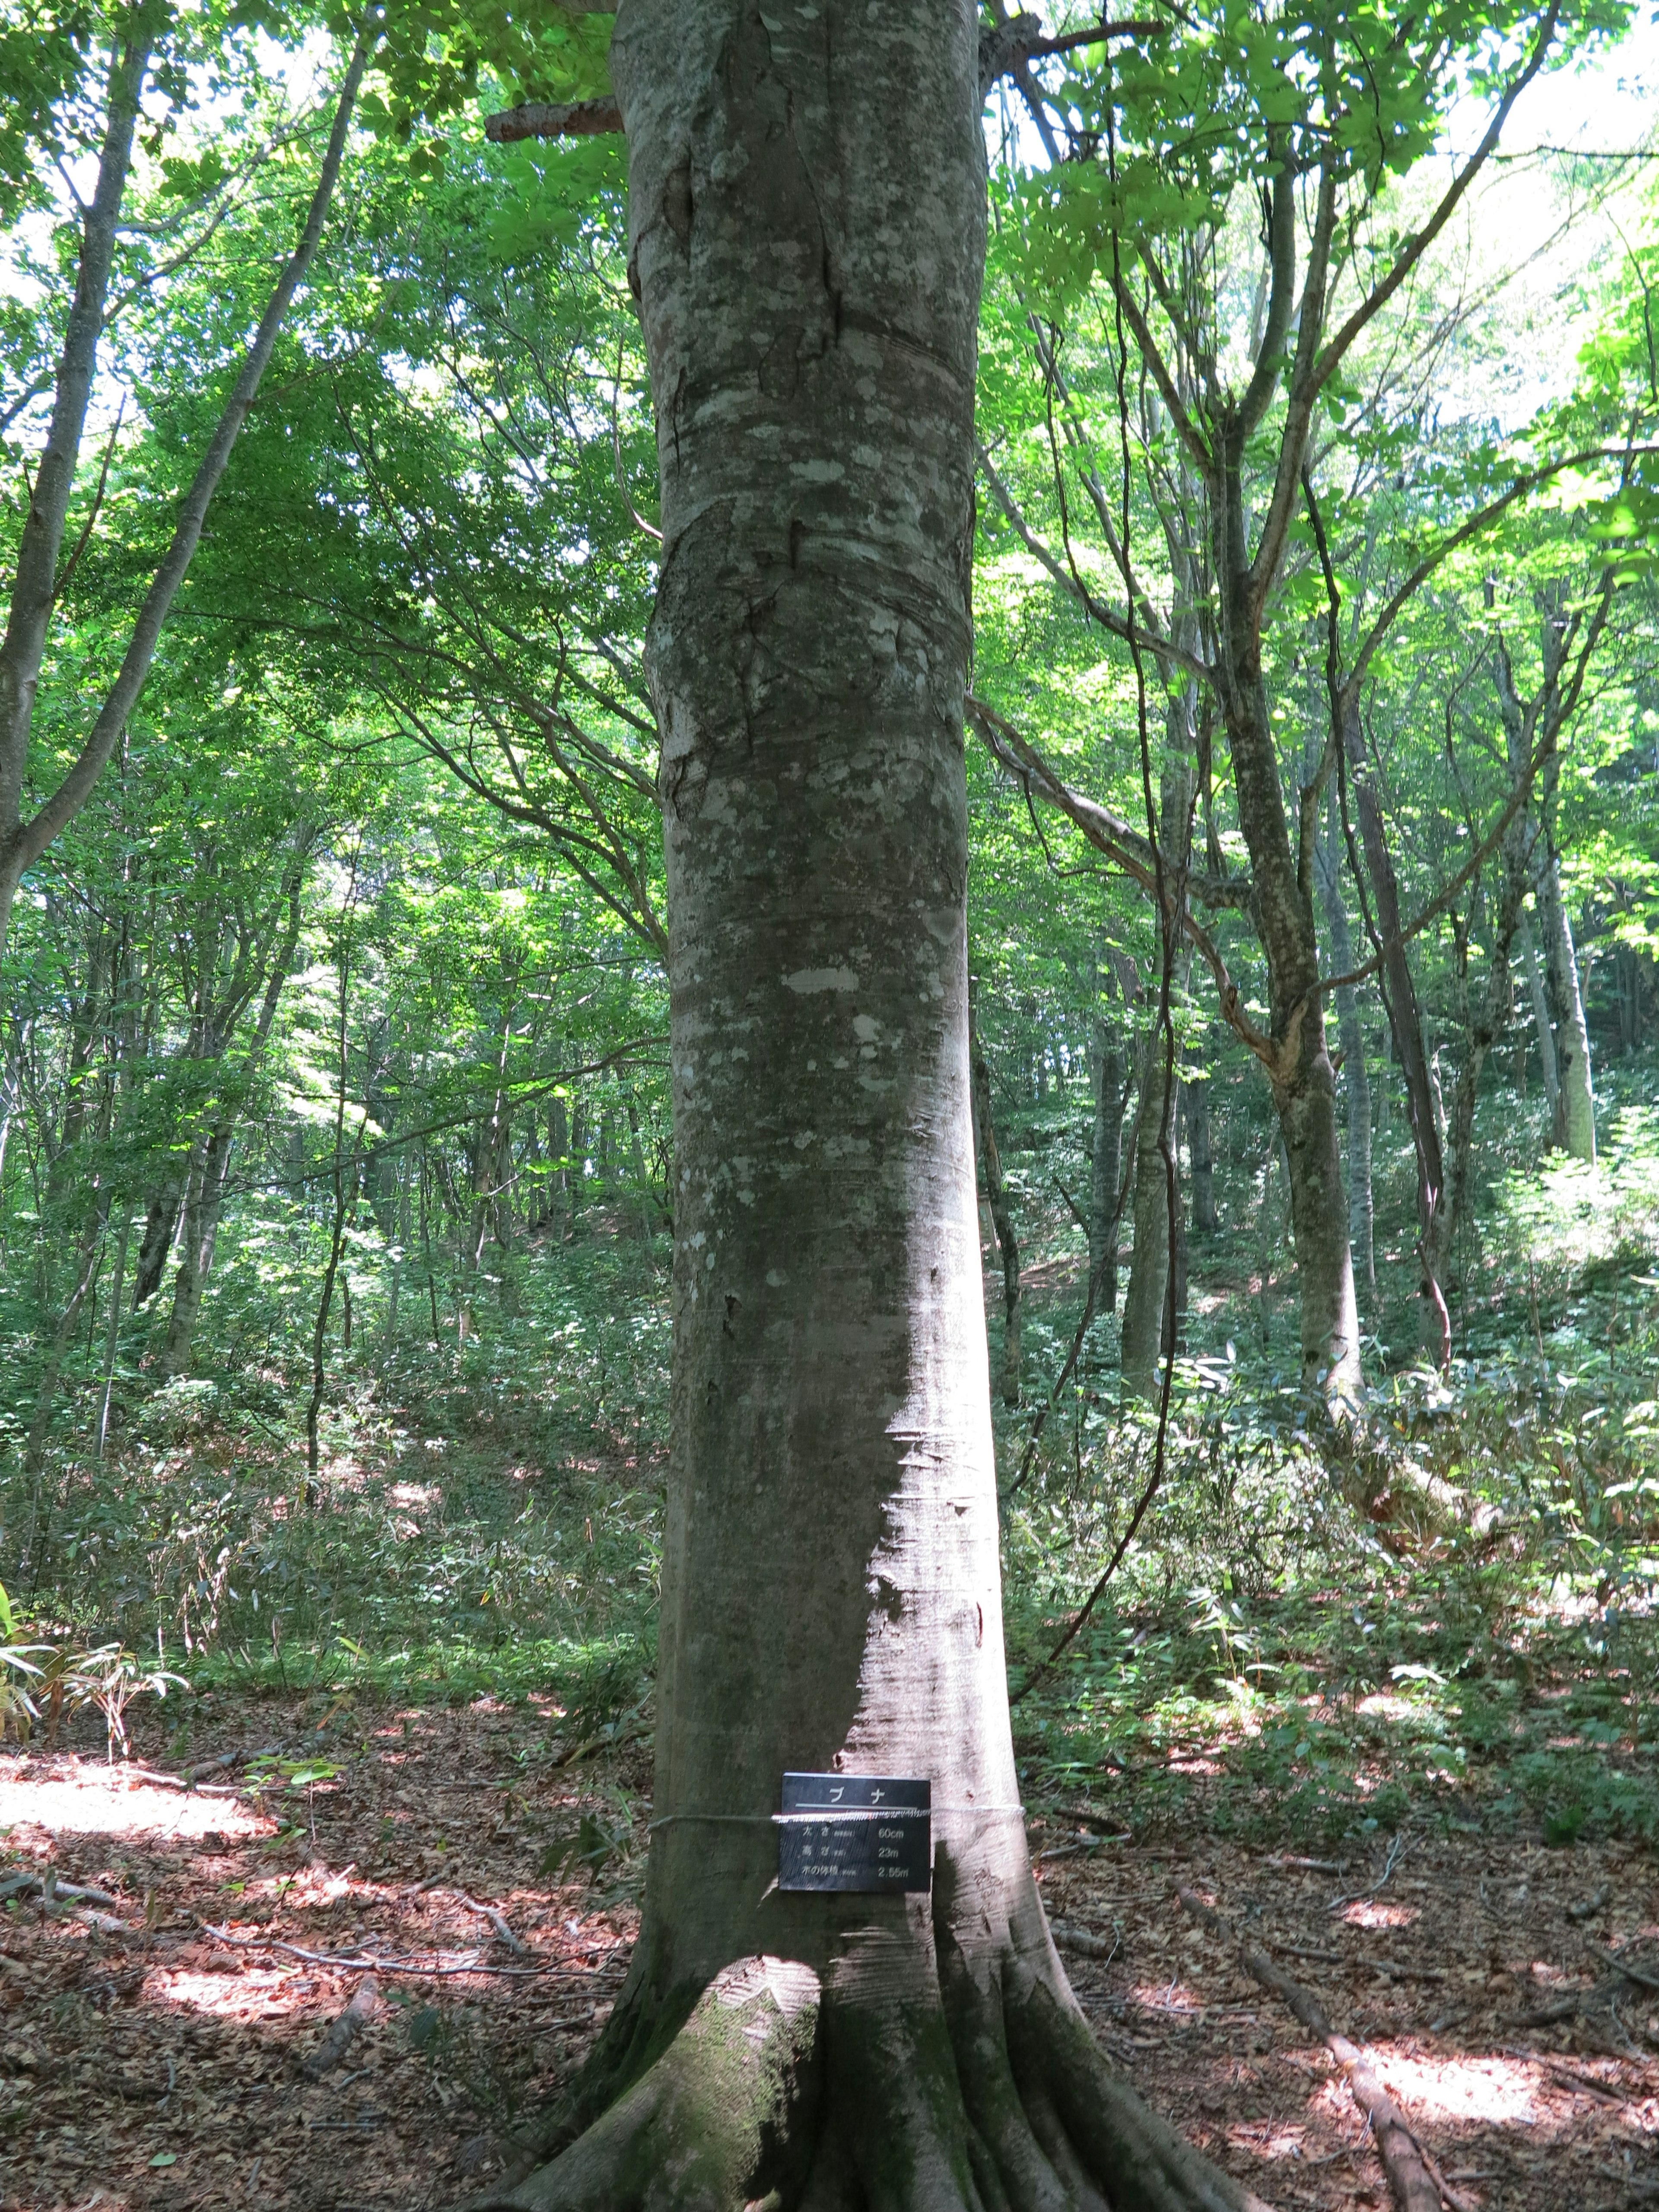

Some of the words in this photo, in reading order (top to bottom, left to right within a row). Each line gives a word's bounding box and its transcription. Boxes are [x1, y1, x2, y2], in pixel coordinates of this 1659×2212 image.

[830, 1786, 885, 1805] ブナ
[878, 1828, 904, 1839] 60cm
[878, 1847, 899, 1858] 23m
